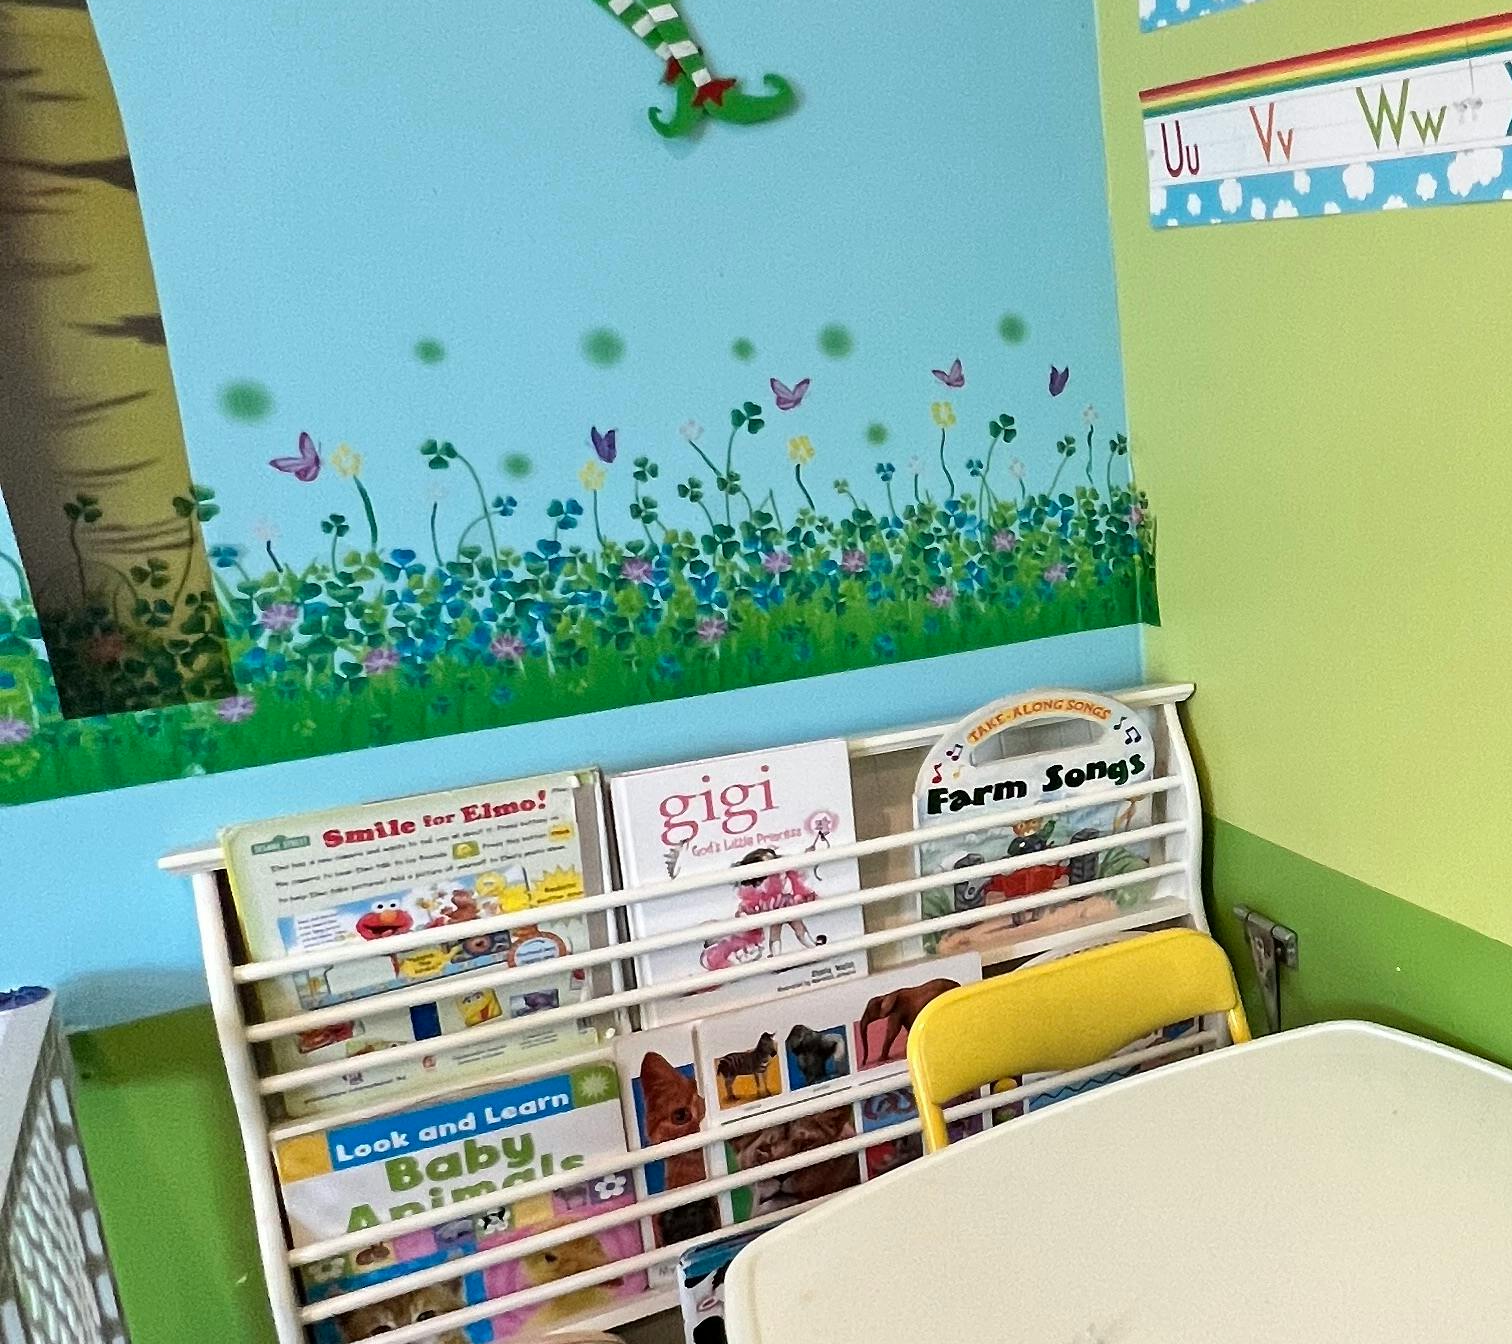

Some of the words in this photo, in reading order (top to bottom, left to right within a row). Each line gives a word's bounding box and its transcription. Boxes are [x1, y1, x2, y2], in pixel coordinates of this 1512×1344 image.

[1160, 122, 1200, 179] Uu
[1251, 104, 1294, 161] Vv
[1356, 80, 1446, 149] Ww
[1066, 699, 1112, 720] SONGS
[659, 764, 780, 846] gigi
[927, 778, 1027, 815] Farm
[1042, 753, 1146, 792] Songs
[322, 819, 416, 848] Smile
[422, 811, 455, 828] for
[460, 790, 547, 824] Elmo!
[335, 1131, 410, 1162] Look
[418, 1112, 476, 1142] and
[484, 1092, 569, 1125] Learn
[385, 1133, 535, 1192] Baby
